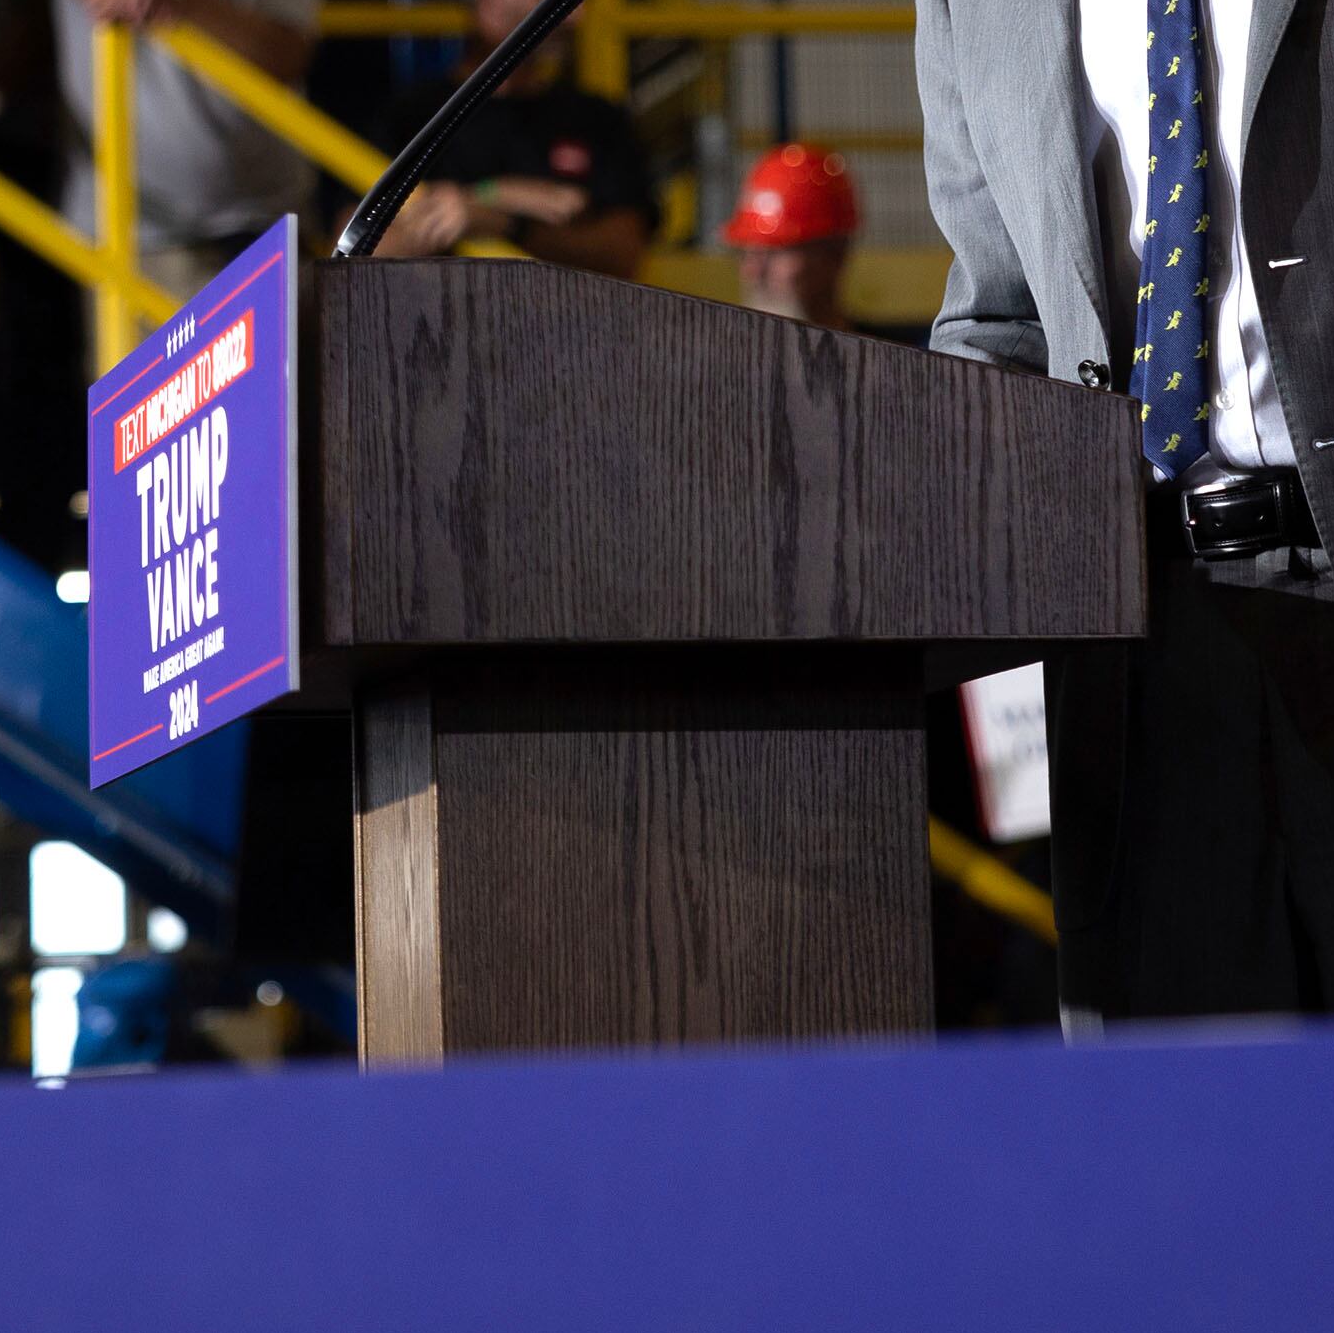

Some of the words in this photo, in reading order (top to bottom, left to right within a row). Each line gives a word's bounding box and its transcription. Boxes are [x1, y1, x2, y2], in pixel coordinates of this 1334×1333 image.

[120, 405, 146, 464] TEXT
[146, 363, 196, 446] MICHIGAN
[196, 351, 212, 404] TO
[212, 321, 247, 392] 88022
[136, 406, 229, 568] TRUMP
[146, 528, 219, 653] VANCE
[143, 664, 160, 694] MAKE
[160, 650, 185, 685] AMERICA
[185, 638, 204, 671] GREAT
[169, 679, 199, 741] 2024
